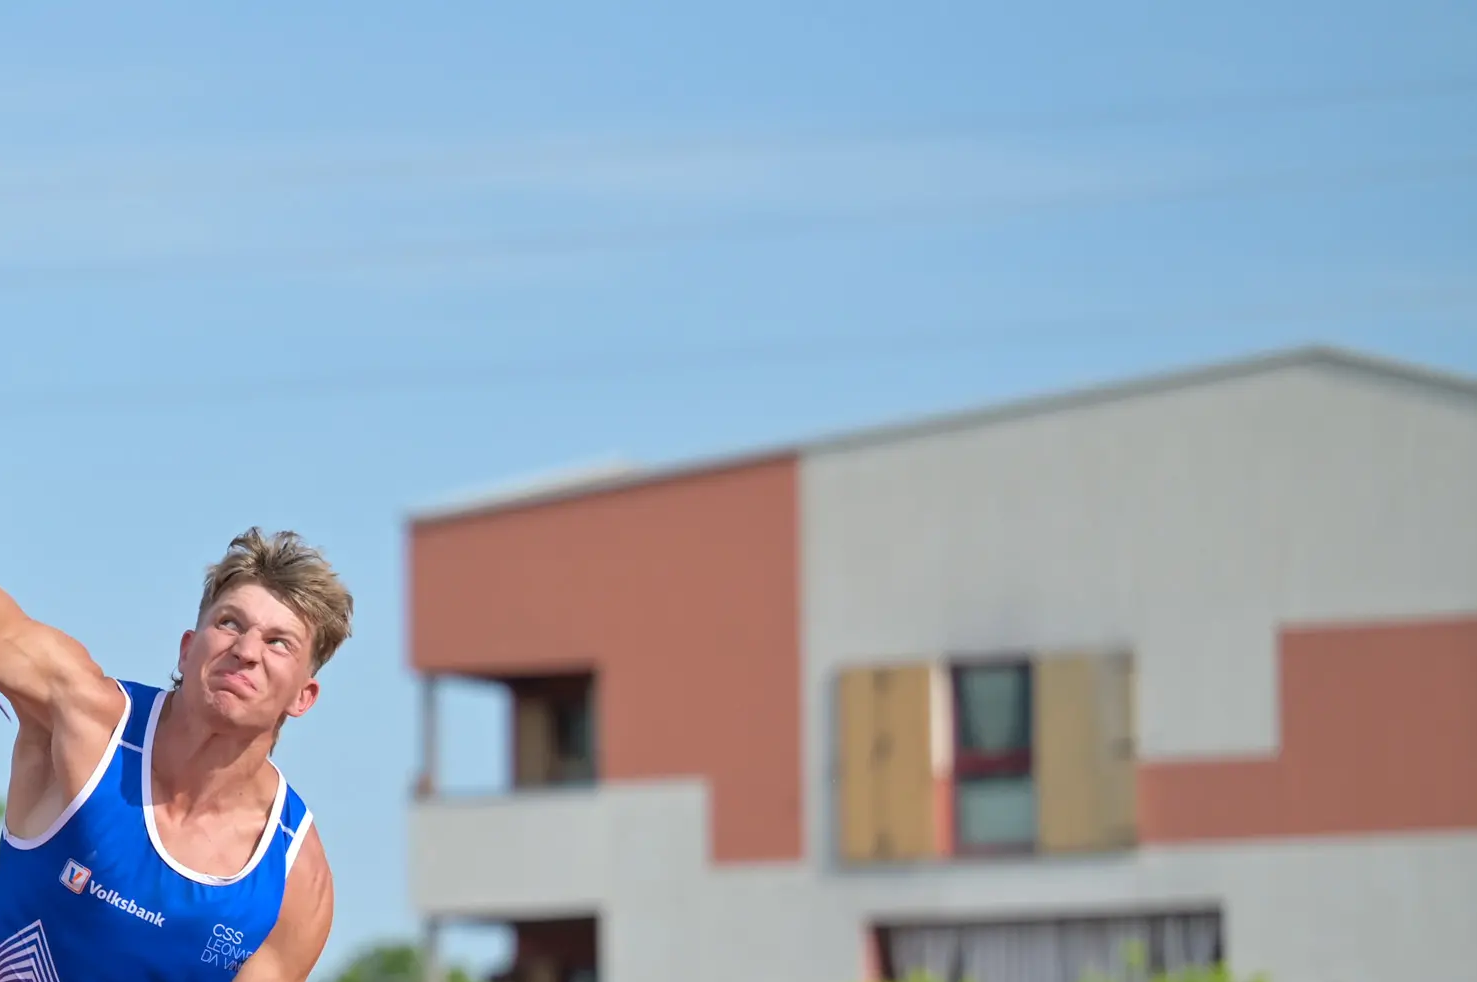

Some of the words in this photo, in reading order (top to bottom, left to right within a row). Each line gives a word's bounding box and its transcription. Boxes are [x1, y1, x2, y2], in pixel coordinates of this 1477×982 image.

[89, 880, 166, 928] Volksbank
[212, 923, 244, 945] CSS
[200, 949, 219, 967] DA
